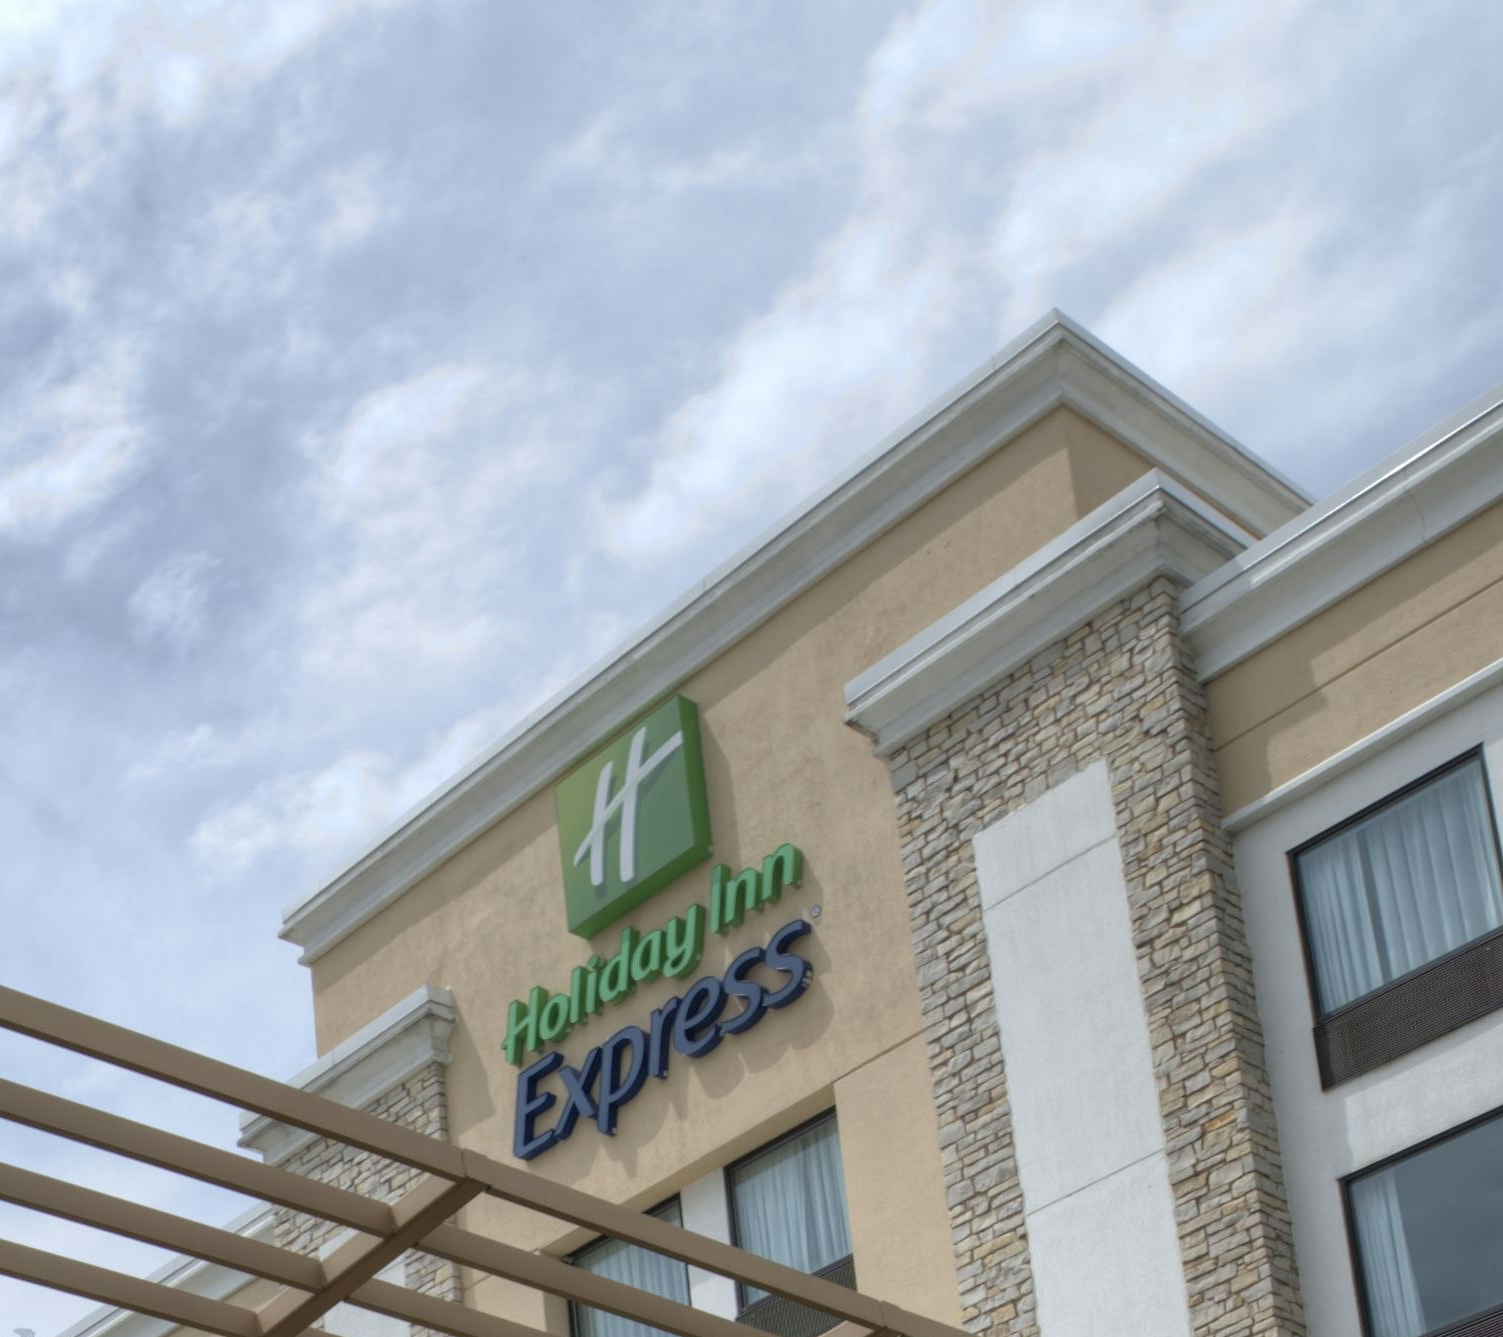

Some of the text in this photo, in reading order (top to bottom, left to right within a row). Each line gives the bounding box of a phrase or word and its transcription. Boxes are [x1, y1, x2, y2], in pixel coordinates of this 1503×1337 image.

[502, 842, 804, 1067] Holiday Inn
[513, 918, 814, 1162] Express
